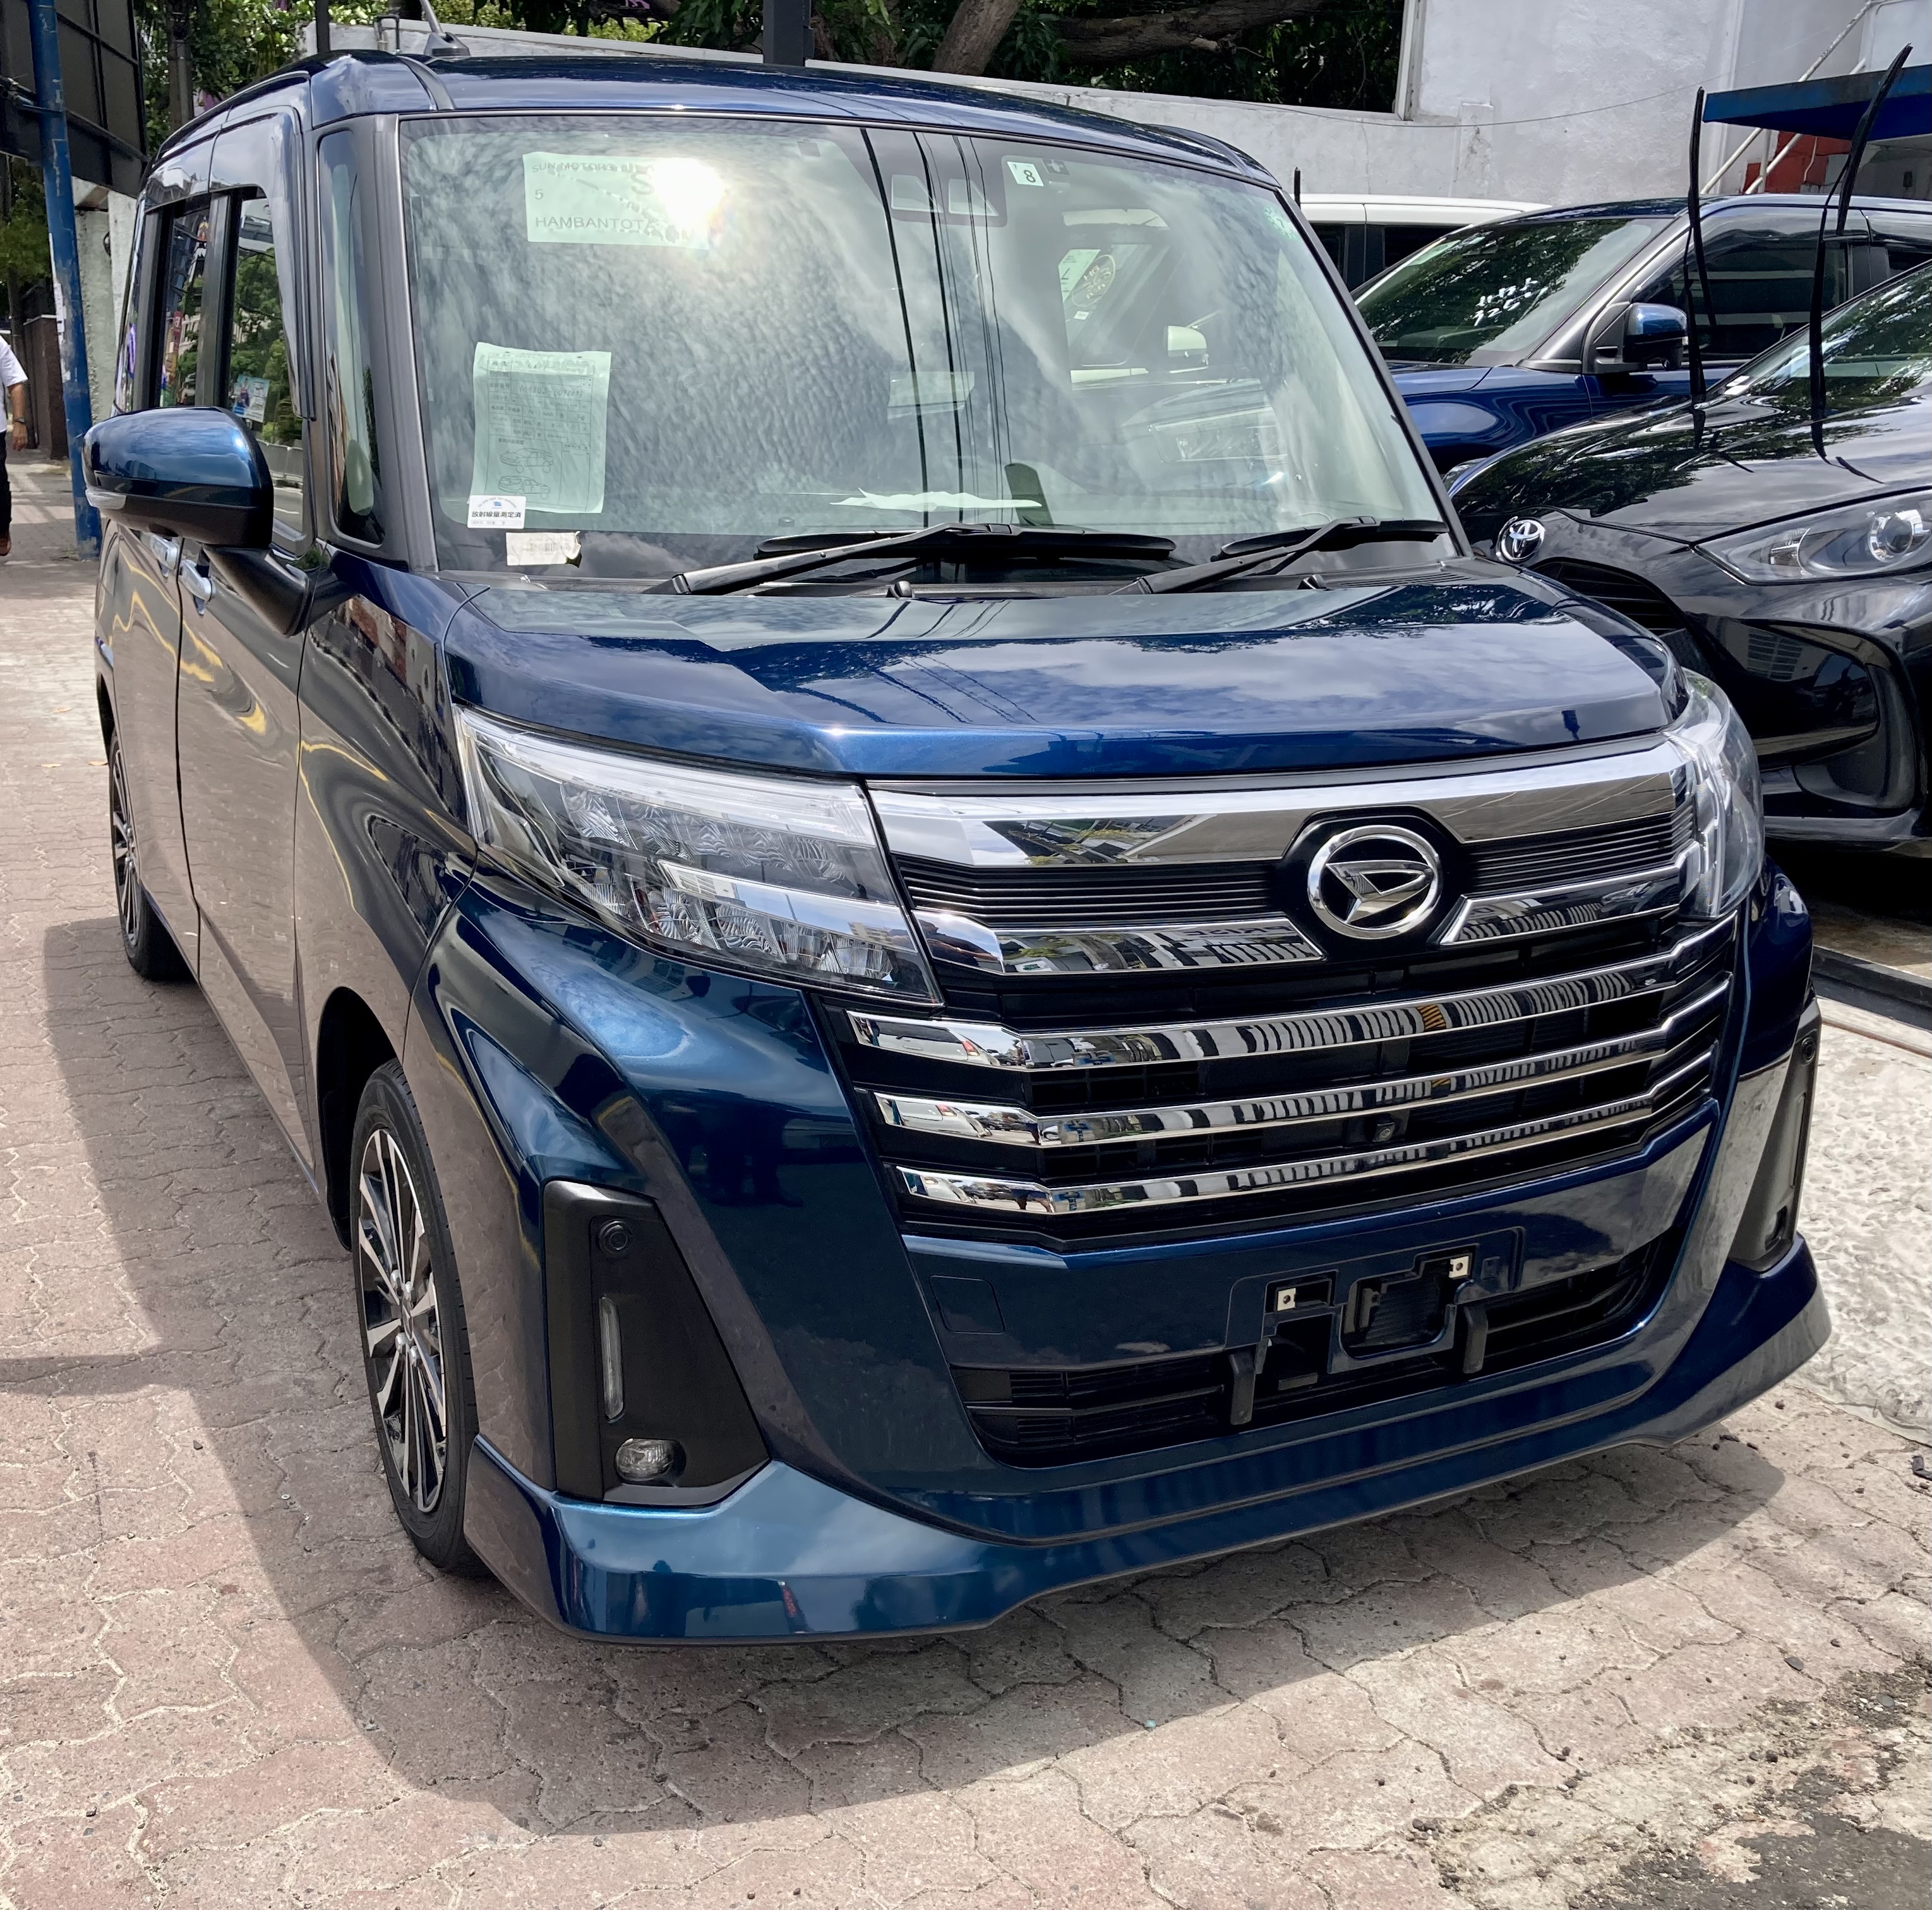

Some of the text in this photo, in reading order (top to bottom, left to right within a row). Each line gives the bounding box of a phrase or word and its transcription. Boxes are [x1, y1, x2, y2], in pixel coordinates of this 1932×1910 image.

[1023, 169, 1036, 183] 8
[535, 189, 543, 200] 5
[536, 217, 655, 233] HAMBANTOTA
